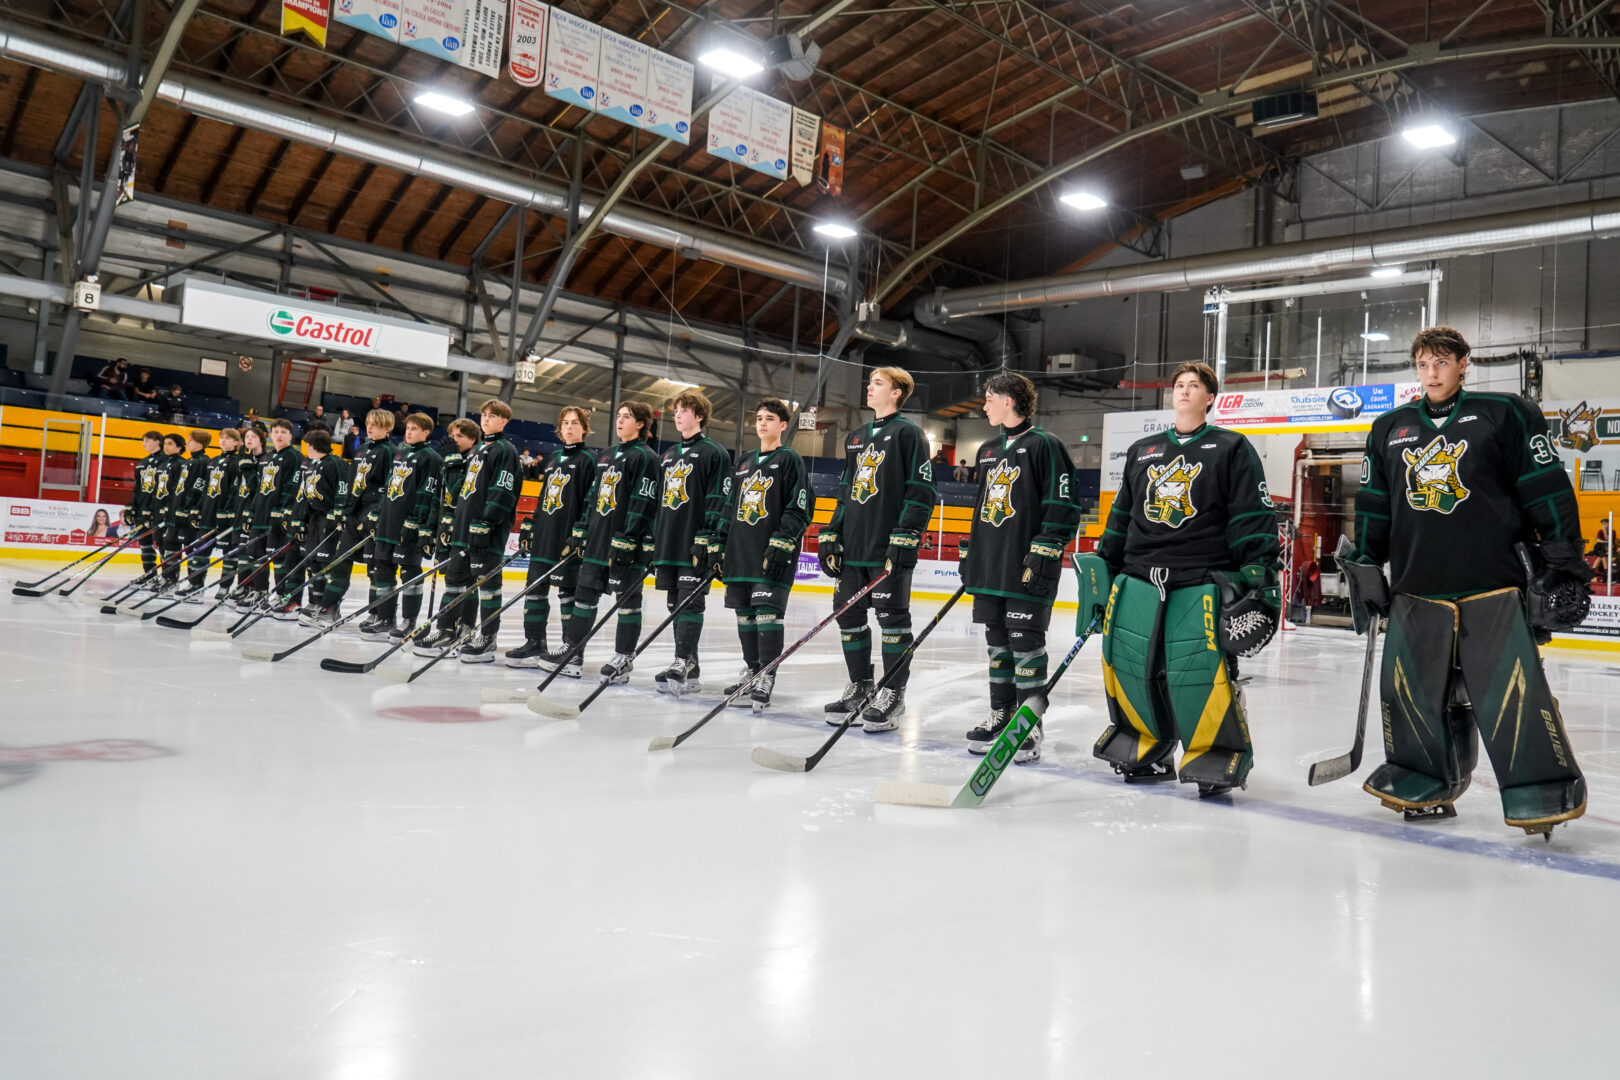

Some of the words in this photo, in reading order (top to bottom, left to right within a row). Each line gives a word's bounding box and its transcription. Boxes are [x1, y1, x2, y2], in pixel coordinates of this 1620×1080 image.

[516, 34, 536, 45] 2003
[85, 293, 94, 304] 8
[295, 316, 372, 347] Castrol
[523, 370, 533, 380] 10
[1217, 394, 1244, 409] IGA
[1389, 436, 1418, 446] KNAPPER
[1414, 440, 1442, 473] GAULOIS
[919, 460, 931, 481] 4
[1155, 461, 1180, 485] GAULOIS
[426, 477, 438, 494] 1
[497, 471, 516, 491] 15
[1030, 544, 1062, 557] CCM
[1007, 611, 1034, 620] CCM
[1103, 583, 1119, 637] CCM
[1203, 595, 1217, 652] CCM
[1063, 637, 1084, 666] CCM
[970, 713, 1031, 797] CCM
